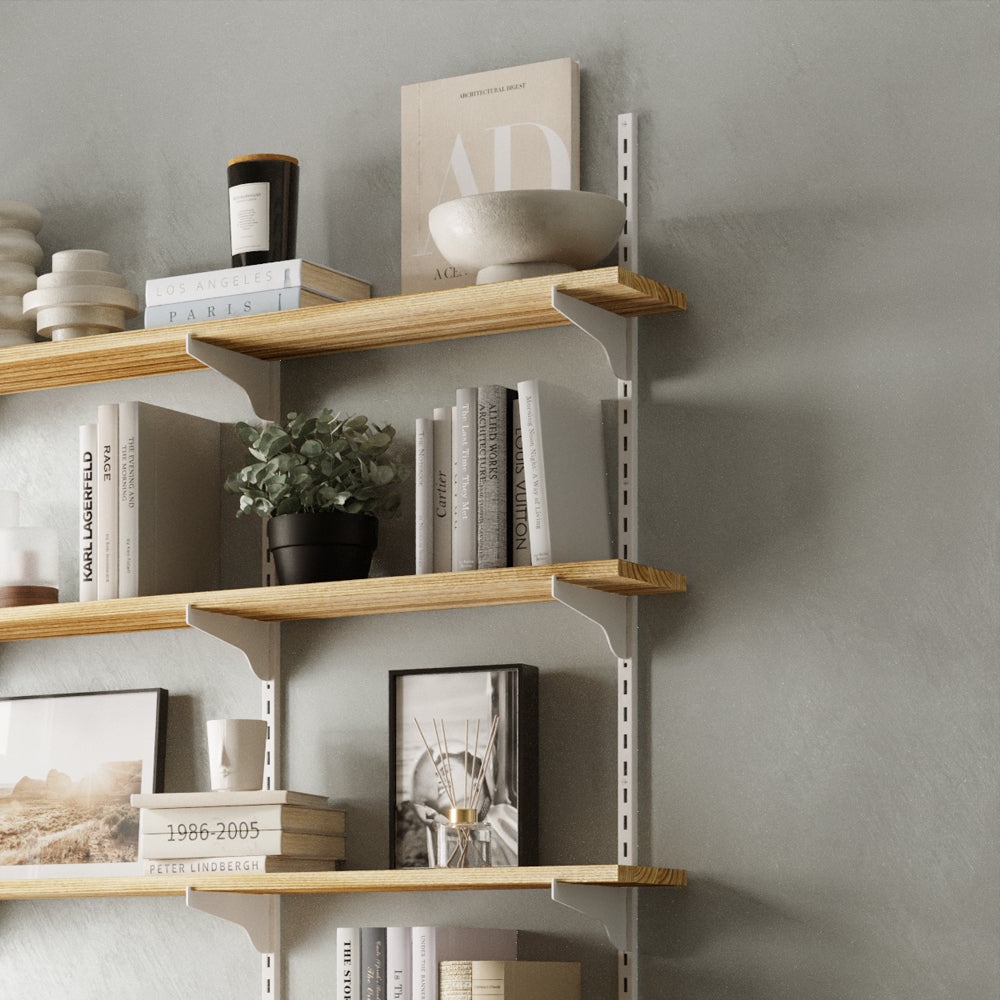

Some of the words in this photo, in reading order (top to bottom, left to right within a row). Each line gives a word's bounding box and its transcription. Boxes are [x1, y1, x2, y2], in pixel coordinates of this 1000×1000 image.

[156, 283, 186, 296] LOS
[196, 270, 273, 290] ANGELES
[169, 300, 252, 322] PARIS
[461, 403, 470, 422] The
[489, 403, 498, 441] ALLIED
[461, 425, 470, 446] Last
[103, 445, 111, 481] RAGE
[461, 448, 470, 472] Time
[489, 444, 498, 480] WORKS
[83, 451, 93, 540] LAGERFELD
[436, 470, 447, 518] Cartier
[461, 474, 470, 499] They
[461, 500, 470, 520] Met
[515, 480, 528, 550] VUITTON
[83, 541, 93, 582] KARL
[167, 821, 260, 842] 1986-2005
[150, 863, 185, 874] PETER
[191, 861, 259, 873] LINDBERGH
[343, 940, 351, 966] THE
[394, 970, 403, 981] Is
